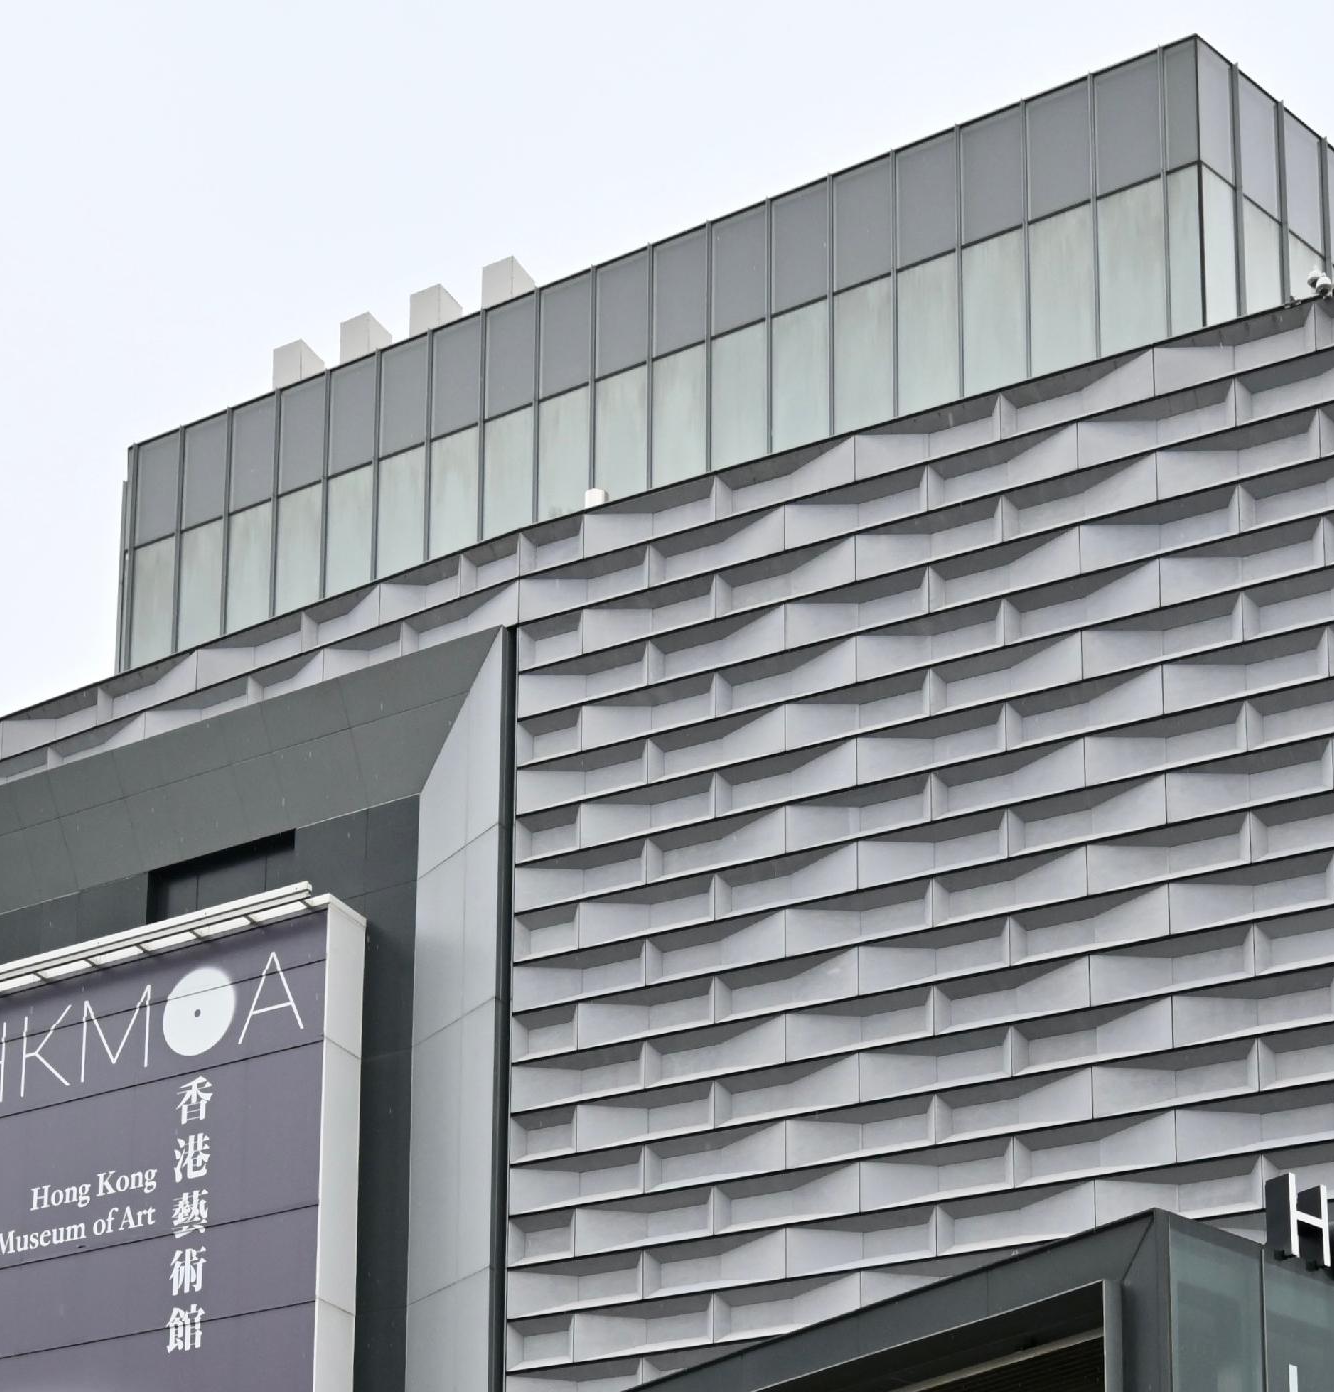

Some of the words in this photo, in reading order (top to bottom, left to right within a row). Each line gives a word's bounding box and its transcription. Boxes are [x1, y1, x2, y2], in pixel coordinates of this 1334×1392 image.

[30, 1181, 91, 1212] Hong
[97, 1167, 158, 1200] Kong
[92, 1208, 118, 1235] of
[118, 1205, 155, 1231] Art
[166, 1077, 213, 1353] 香港藝術館
